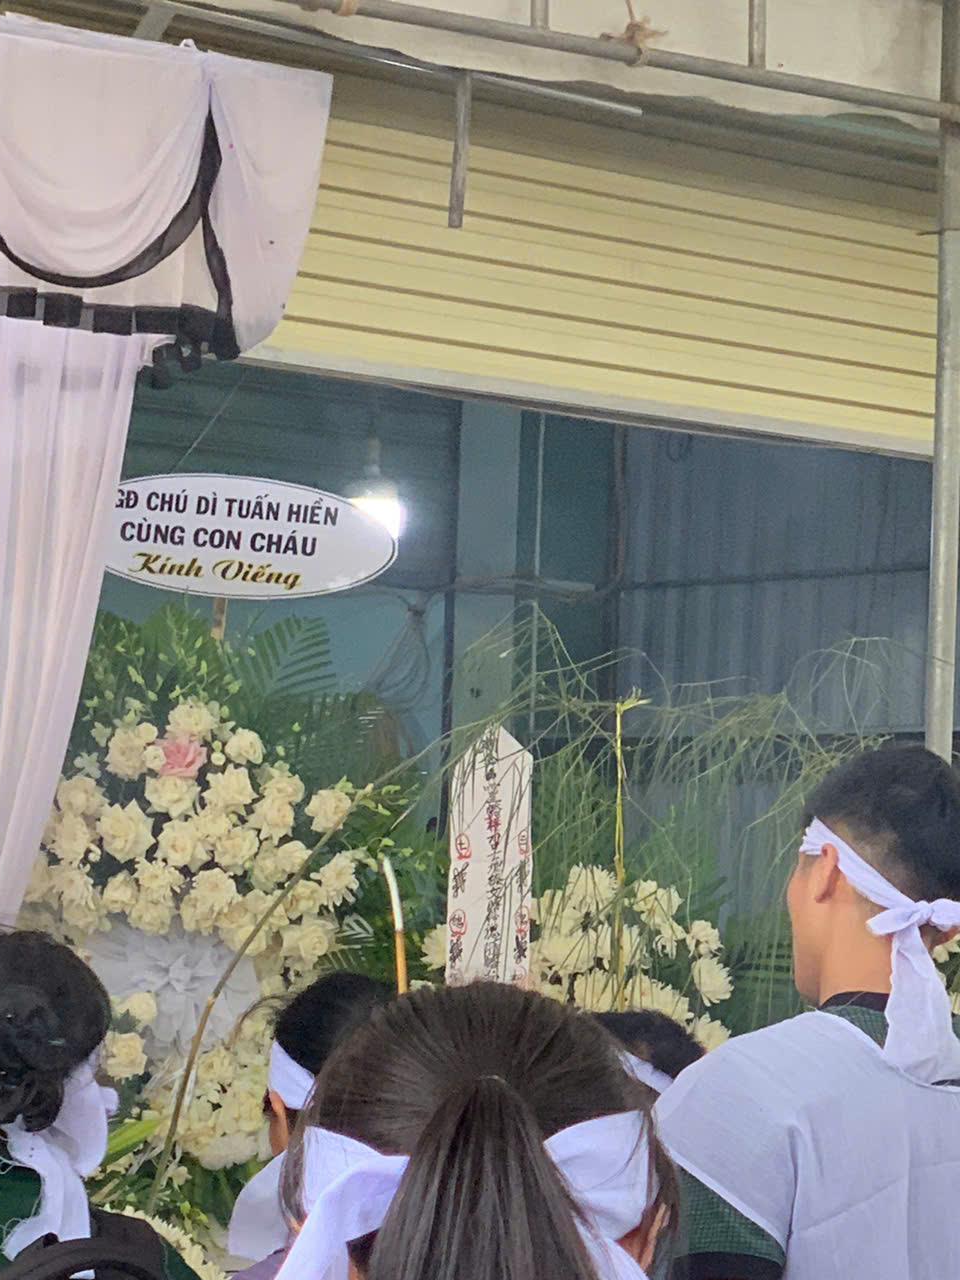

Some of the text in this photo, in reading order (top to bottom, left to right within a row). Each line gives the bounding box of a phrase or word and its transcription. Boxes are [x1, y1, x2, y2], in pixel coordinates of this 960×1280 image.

[146, 489, 189, 514] CHÚ
[196, 492, 218, 516] DÌ
[225, 494, 280, 521] TUẤN
[287, 497, 339, 527] HIỀN
[120, 517, 317, 556] CÙNG CON CHÁU
[128, 552, 302, 591] Kính Viếng
